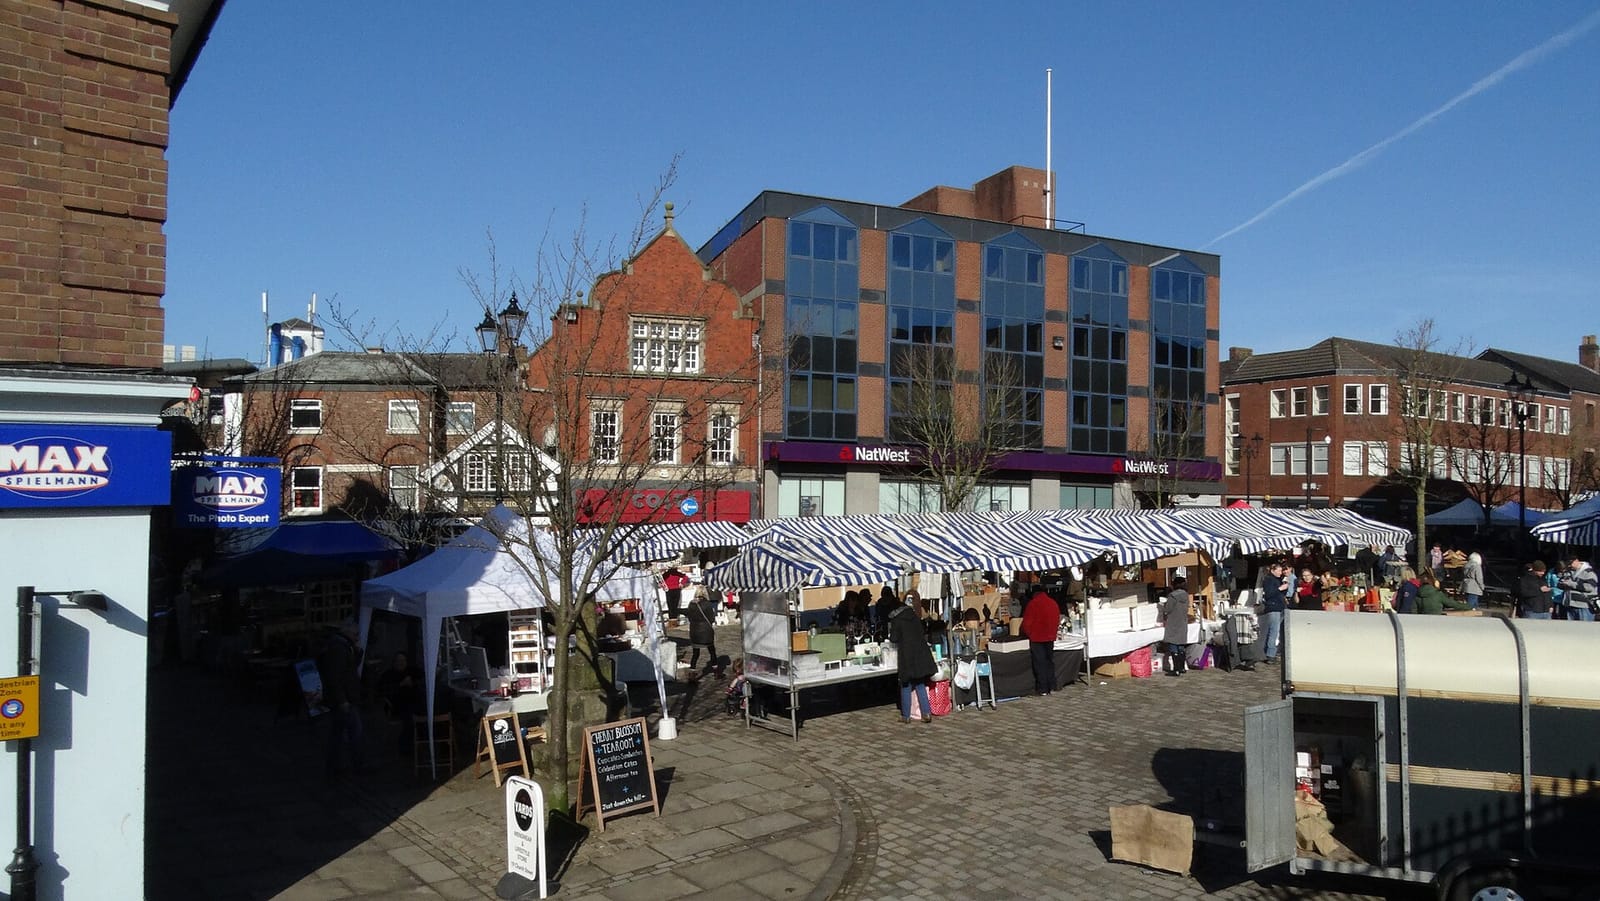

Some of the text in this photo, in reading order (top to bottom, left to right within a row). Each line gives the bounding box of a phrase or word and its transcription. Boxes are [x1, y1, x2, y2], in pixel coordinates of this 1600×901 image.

[0, 445, 109, 471] MAX
[855, 446, 910, 462] NatWest
[1125, 459, 1169, 474] NatWest
[6, 477, 98, 485] SPIELMANN
[195, 476, 265, 494] MAX
[188, 514, 269, 524] The Photo Expert
[591, 722, 642, 745] CHERRY BLOSSOM
[601, 737, 635, 754] TEAROOM
[514, 801, 533, 818] YARDS
